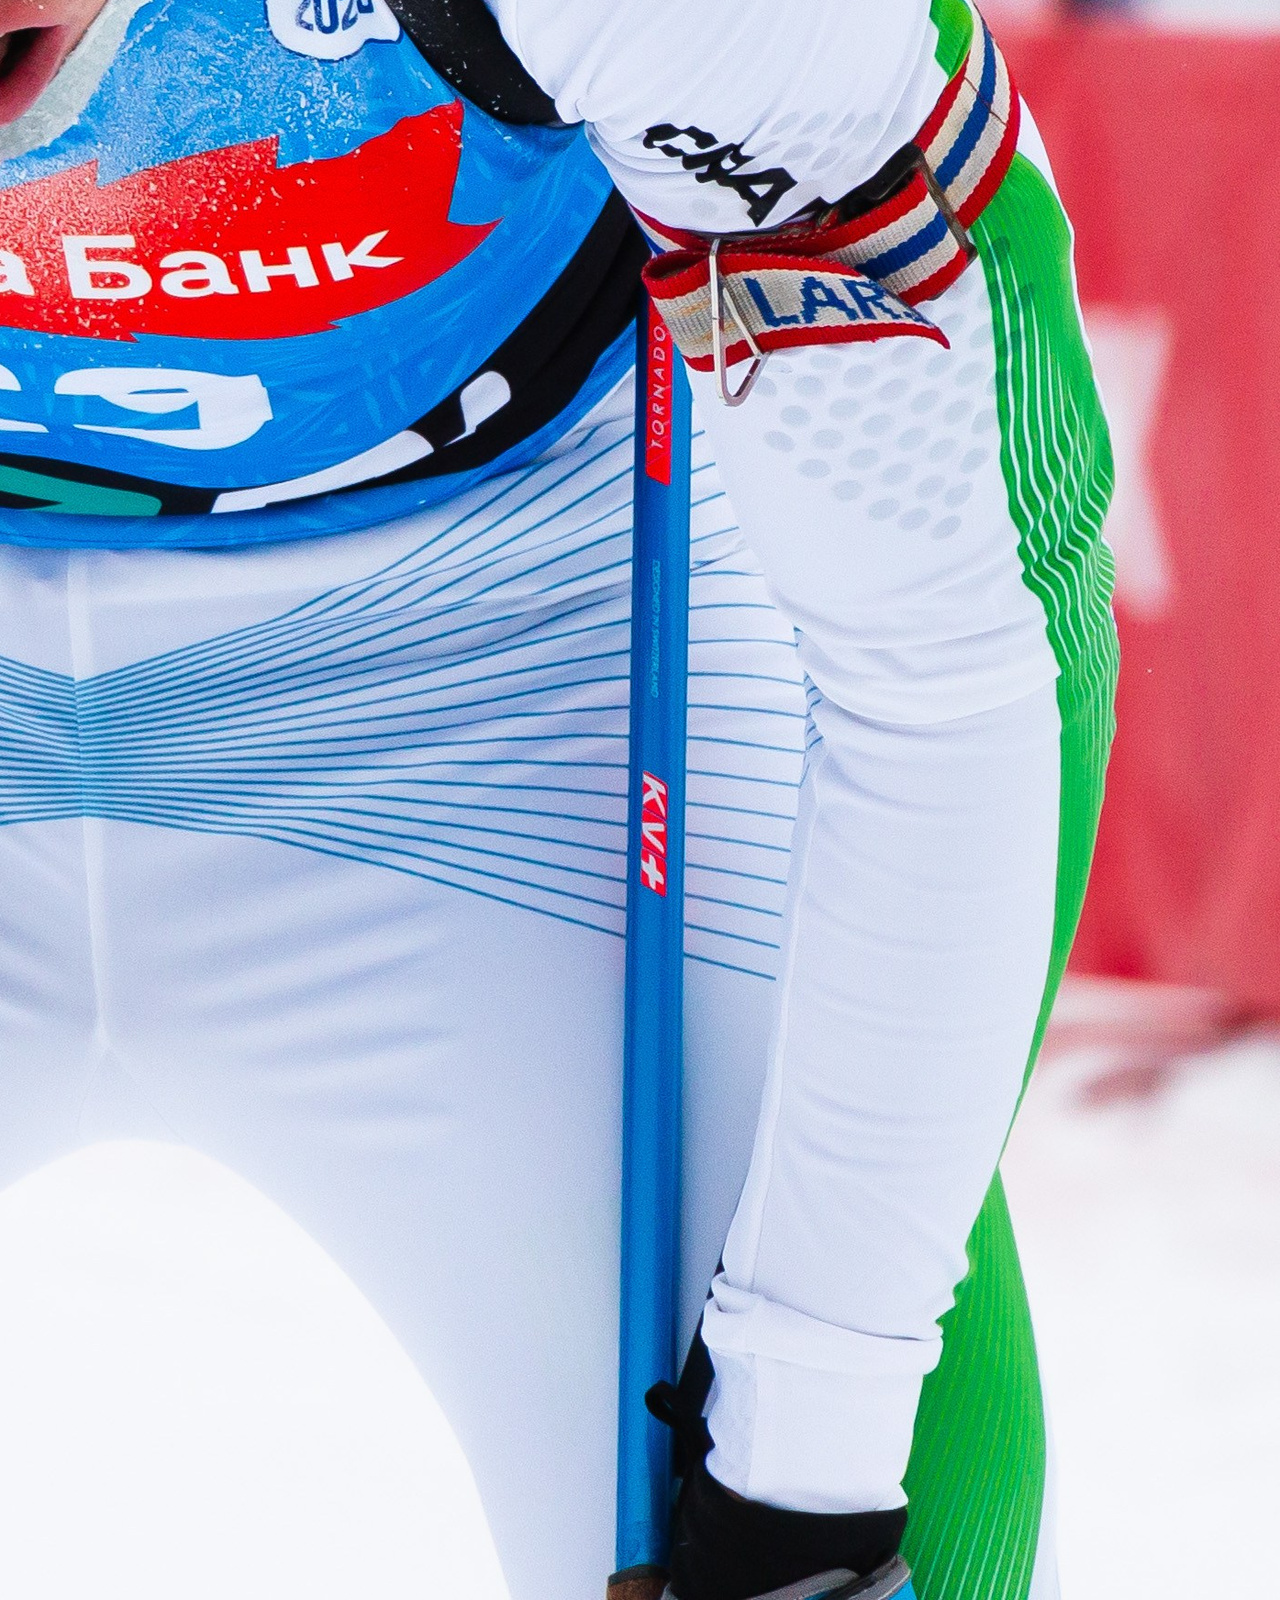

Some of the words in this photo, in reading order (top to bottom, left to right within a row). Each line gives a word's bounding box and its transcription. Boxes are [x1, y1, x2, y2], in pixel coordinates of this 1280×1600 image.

[62, 229, 405, 301] Банк
[743, 276, 933, 329] LAR
[651, 325, 667, 451] TORNADO
